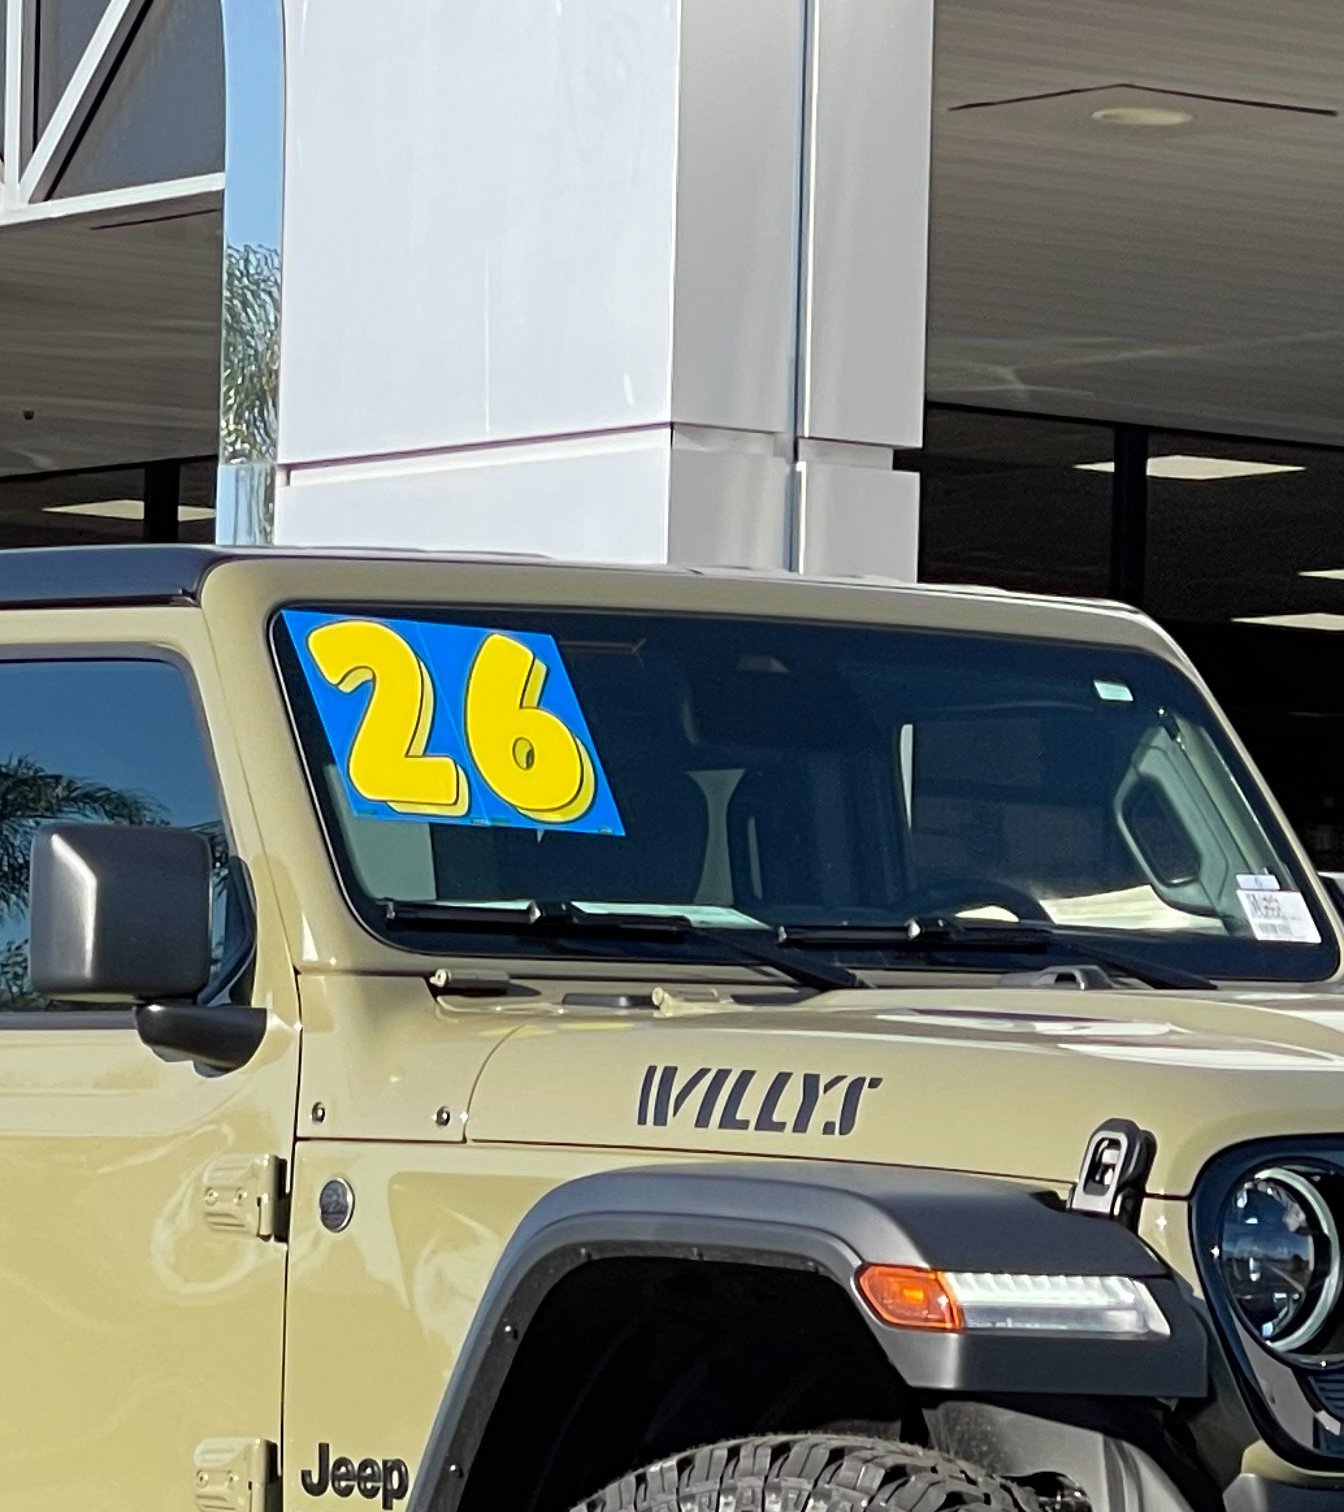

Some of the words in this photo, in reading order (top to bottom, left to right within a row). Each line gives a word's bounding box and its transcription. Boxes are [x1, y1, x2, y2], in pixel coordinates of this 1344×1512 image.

[307, 619, 595, 823] 26
[637, 1064, 883, 1136] WILLYS
[300, 1442, 409, 1511] Jeep
